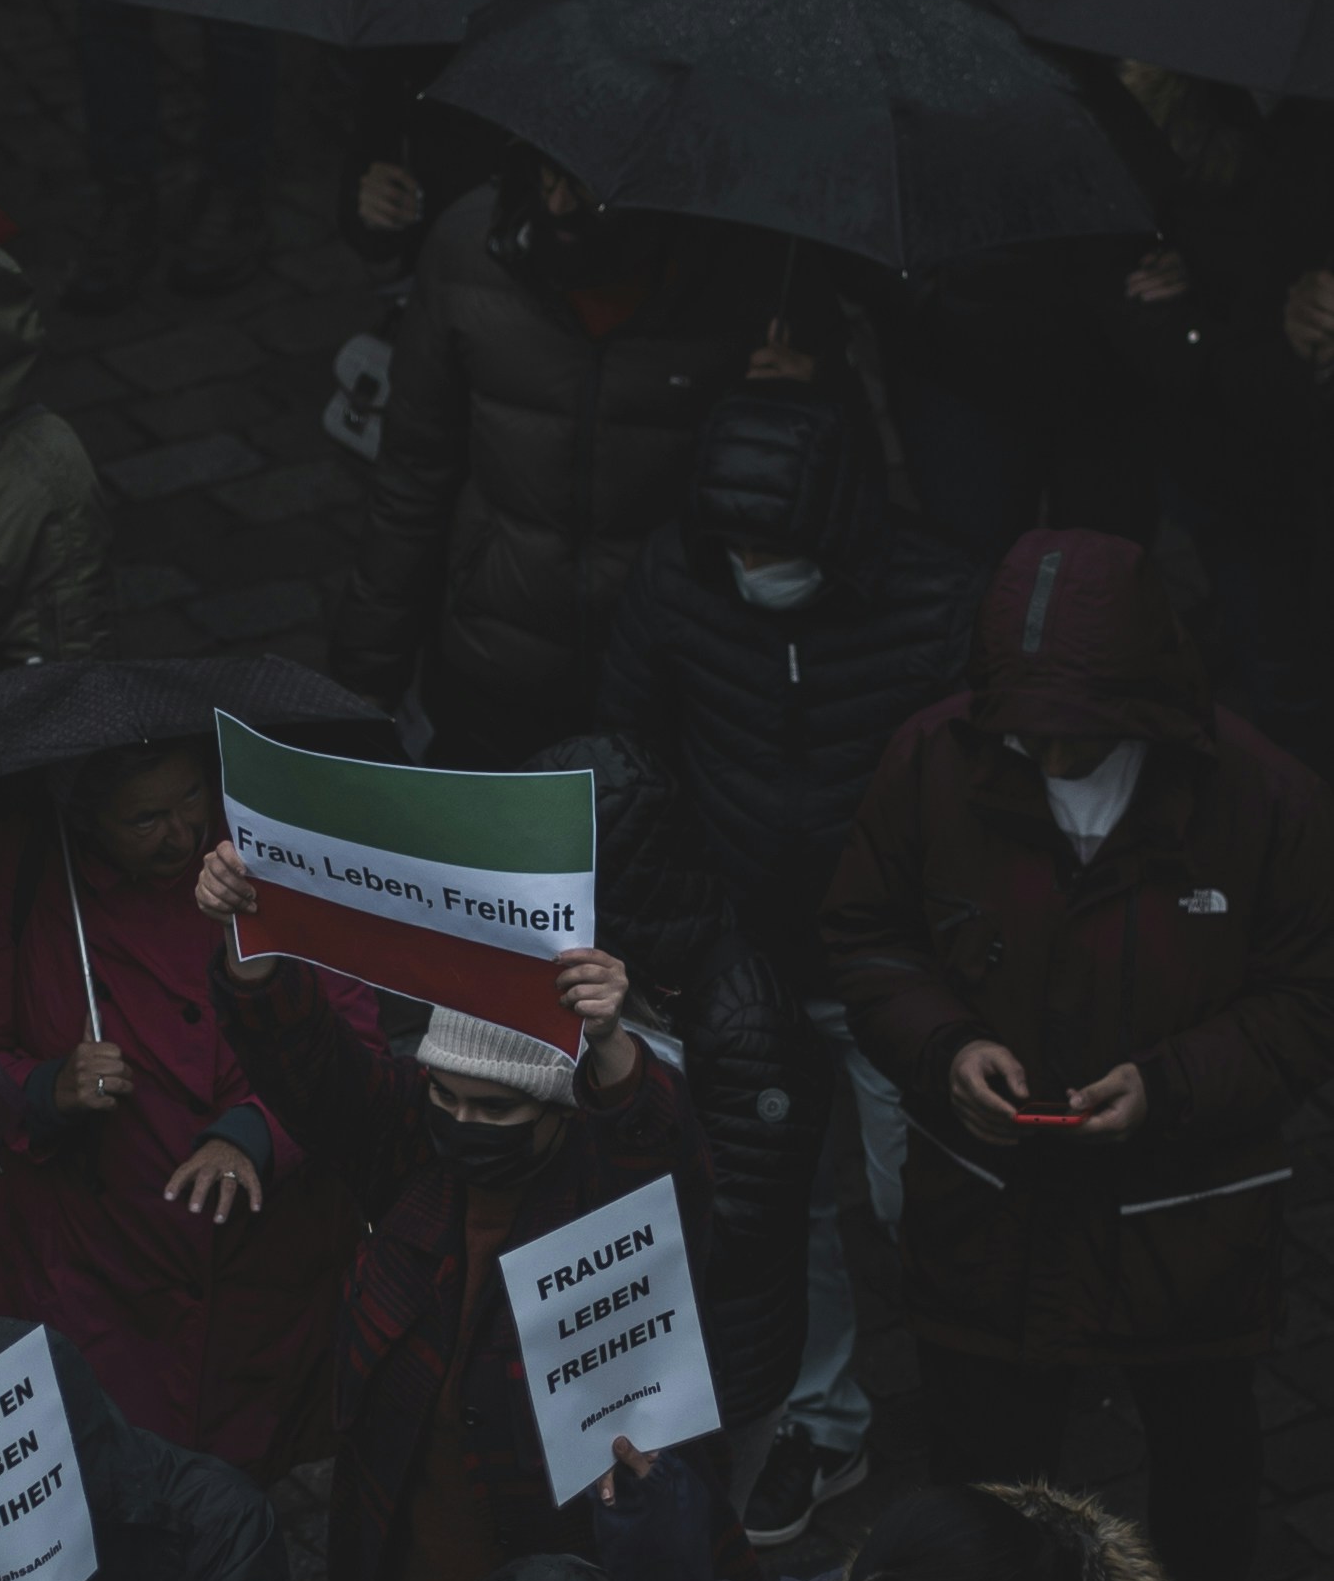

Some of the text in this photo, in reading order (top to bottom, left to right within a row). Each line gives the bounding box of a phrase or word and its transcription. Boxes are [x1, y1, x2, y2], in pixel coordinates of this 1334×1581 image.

[237, 826, 575, 932] Frau, Leben, Freiheit
[536, 1224, 655, 1301] FRAUEN
[558, 1275, 650, 1340] LEBEN
[547, 1309, 676, 1395] FREIHEIT
[580, 1381, 662, 1432] #MahsaAmini
